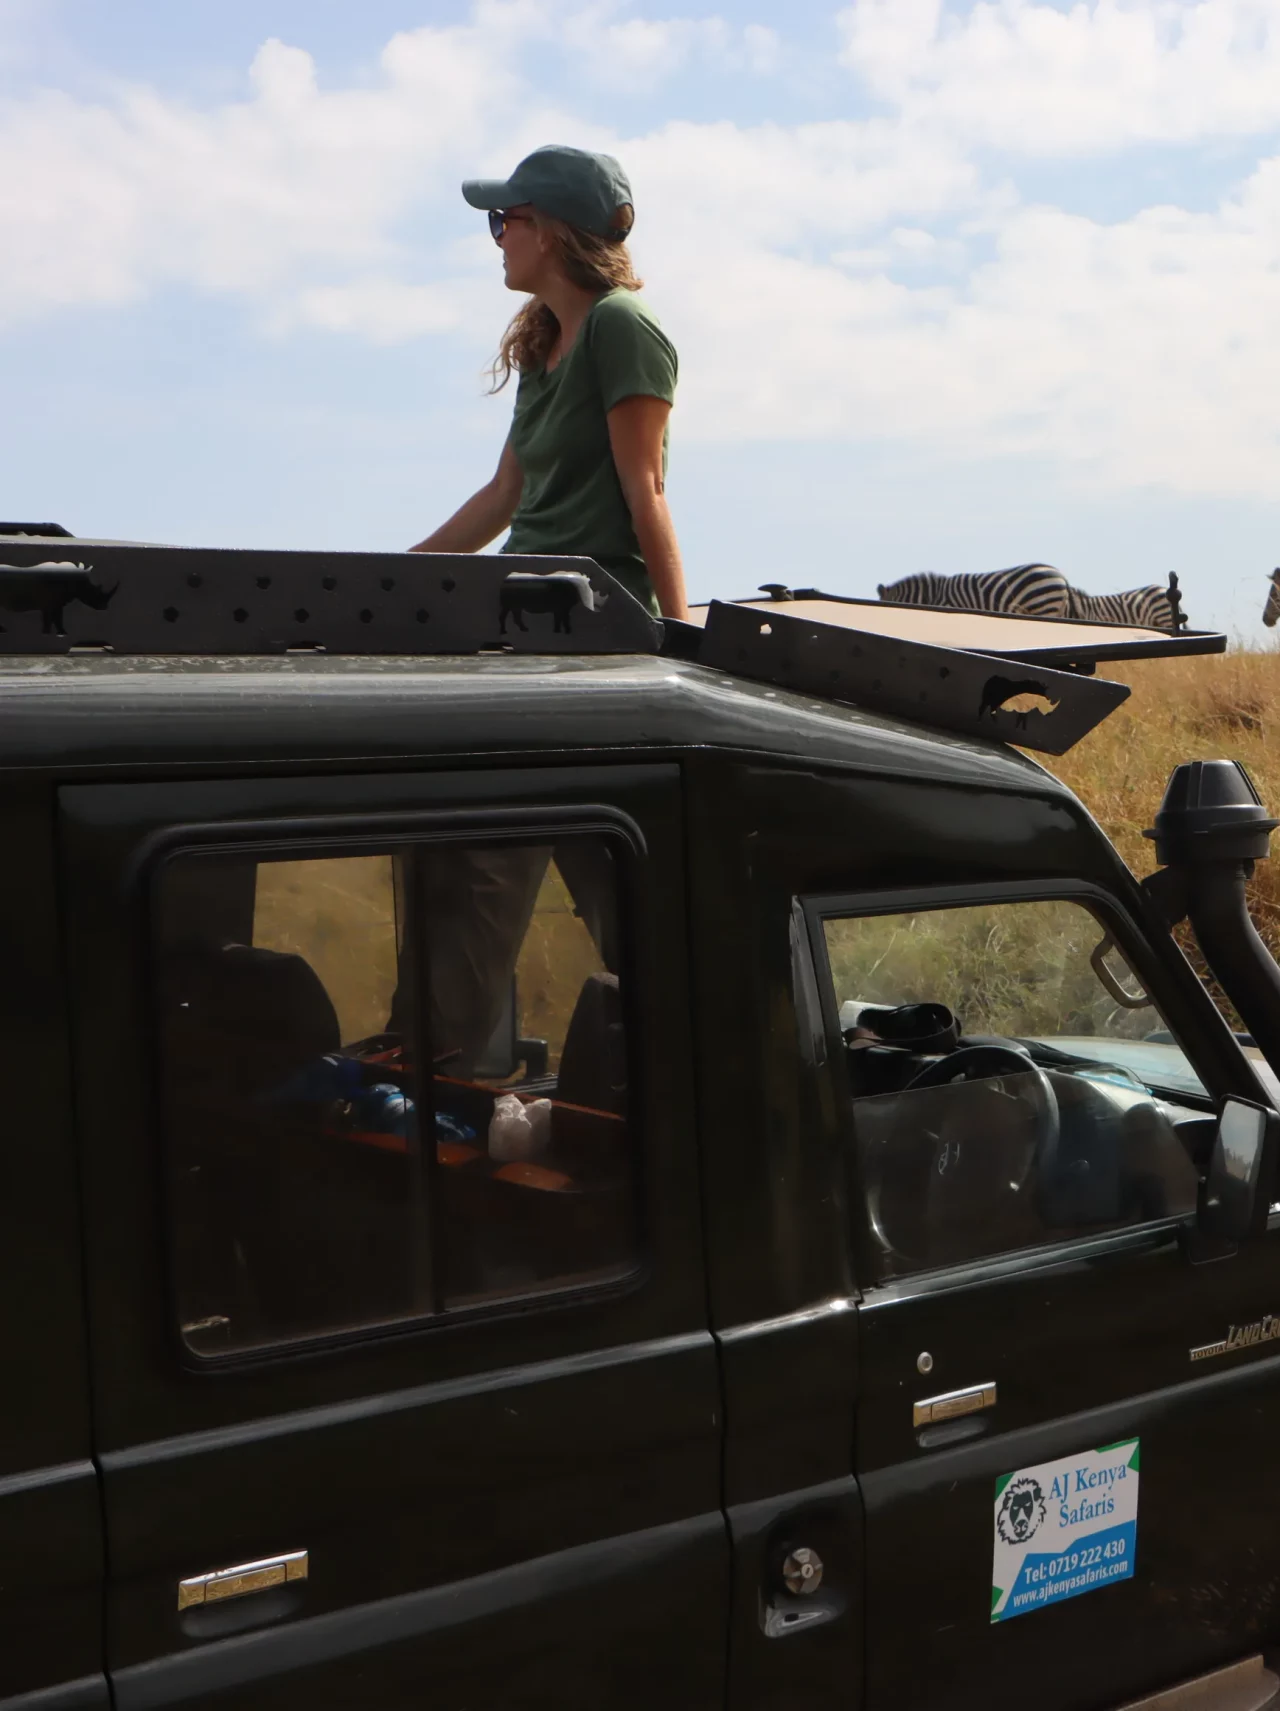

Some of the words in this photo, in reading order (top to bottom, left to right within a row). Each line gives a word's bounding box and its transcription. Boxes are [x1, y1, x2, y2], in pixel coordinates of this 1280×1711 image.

[1049, 1473, 1070, 1503] AJ
[1075, 1464, 1127, 1492] Kenya
[1059, 1493, 1114, 1528] Safaris
[1025, 1562, 1047, 1584] Tel:
[1049, 1552, 1078, 1576] 0719
[1080, 1546, 1101, 1568] 222
[1103, 1538, 1125, 1560] 430
[1013, 1560, 1128, 1607] www.ajkenyasafaris.com
